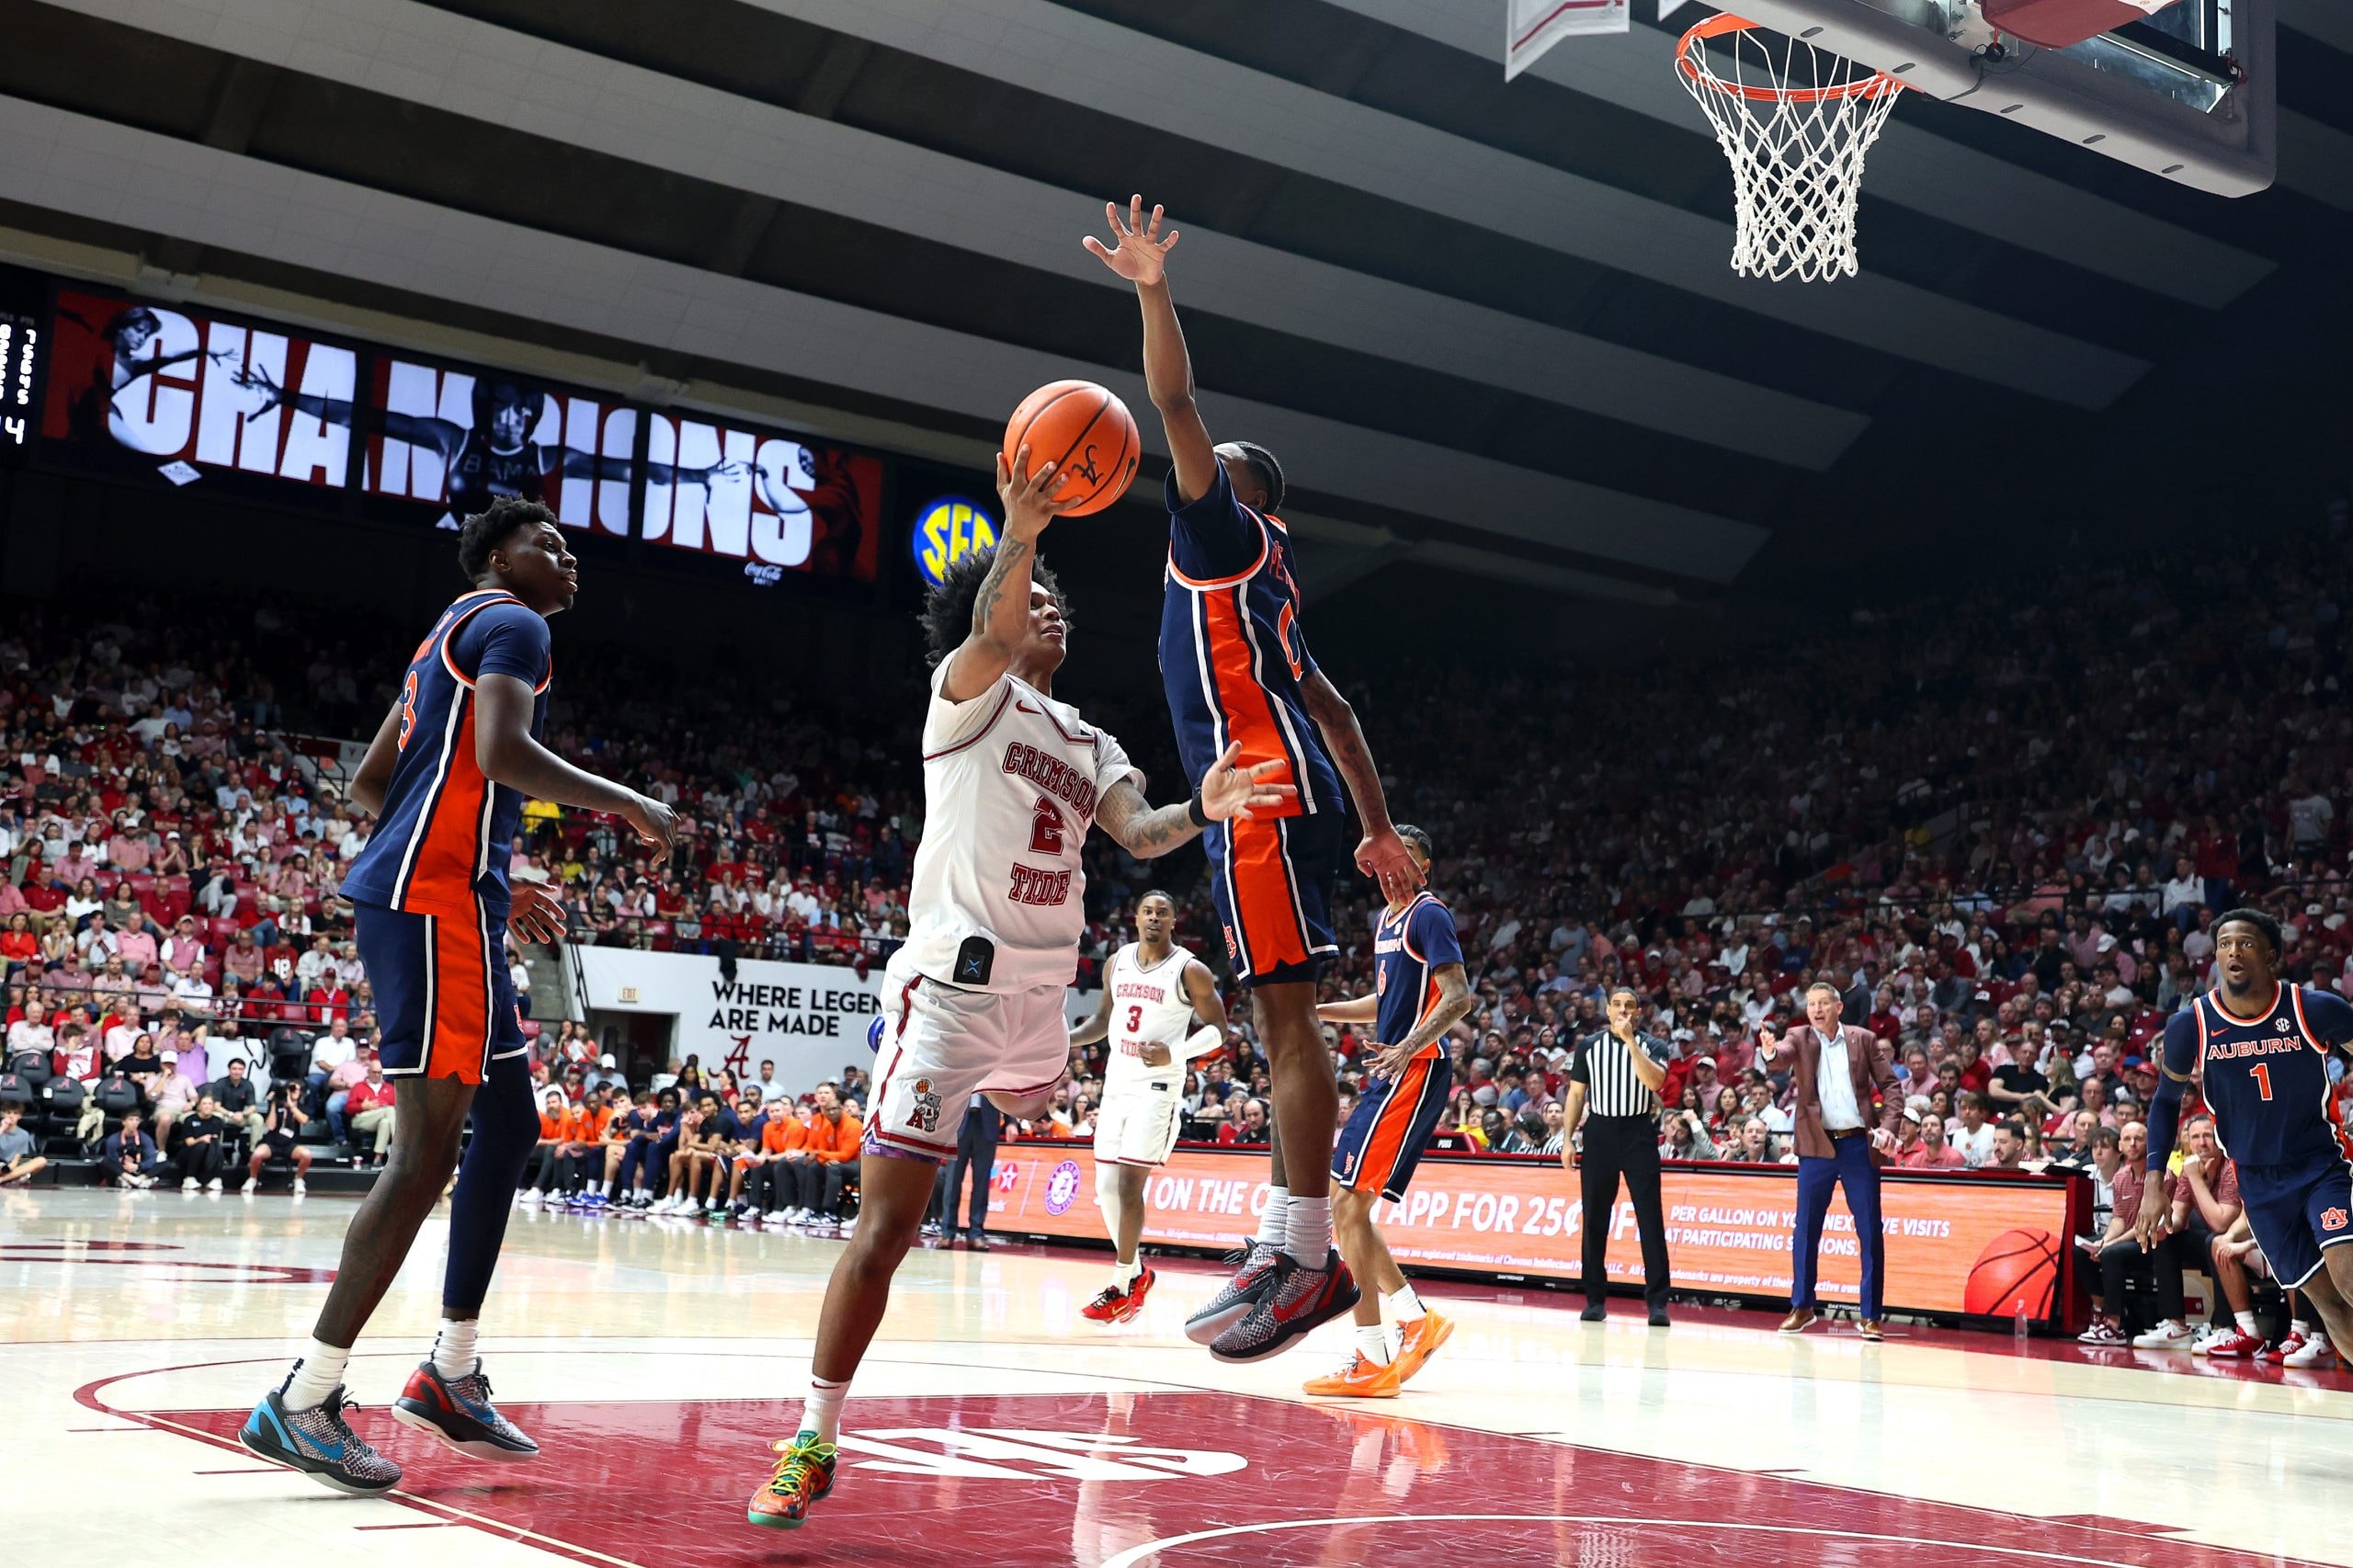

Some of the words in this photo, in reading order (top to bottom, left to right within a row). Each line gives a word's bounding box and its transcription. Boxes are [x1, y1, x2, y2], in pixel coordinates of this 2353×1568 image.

[5, 416, 25, 444] 4
[108, 306, 816, 566] CHAMIONS
[1002, 741, 1097, 823] CRIMSON
[1029, 793, 1066, 856] 2
[1008, 862, 1072, 906] TIDE
[711, 980, 801, 1009] WHERE
[811, 989, 883, 1016] LEGEN
[1117, 983, 1165, 1005] CRIMSON
[708, 1008, 759, 1031] ARE
[767, 1012, 839, 1037] MADE
[1126, 1005, 1142, 1033] 3
[2275, 1017, 2291, 1032] SEC
[708, 1034, 752, 1080] A
[2207, 1036, 2302, 1060] AUBURN
[2249, 1062, 2273, 1101] 1
[905, 1108, 923, 1130] A
[1154, 1176, 1194, 1211] ON
[1198, 1179, 1248, 1214] THE
[1385, 1190, 1449, 1229] APP
[1451, 1193, 1519, 1233] FOR
[1522, 1197, 1584, 1237] 25¢
[1670, 1205, 1697, 1222] PER
[1699, 1207, 1755, 1225] GALLON
[1756, 1210, 1779, 1227] ON
[1781, 1211, 1797, 1229] YO
[1823, 1213, 1857, 1232] NEX
[1882, 1217, 1900, 1234] VE
[1903, 1218, 1950, 1238] VISITS
[1665, 1227, 1681, 1244] AT
[1681, 1229, 1784, 1251] PARTICIPATING
[1786, 1235, 1859, 1256] SIONS.
[1723, 1274, 1760, 1287] property
[1762, 1275, 1773, 1286] of
